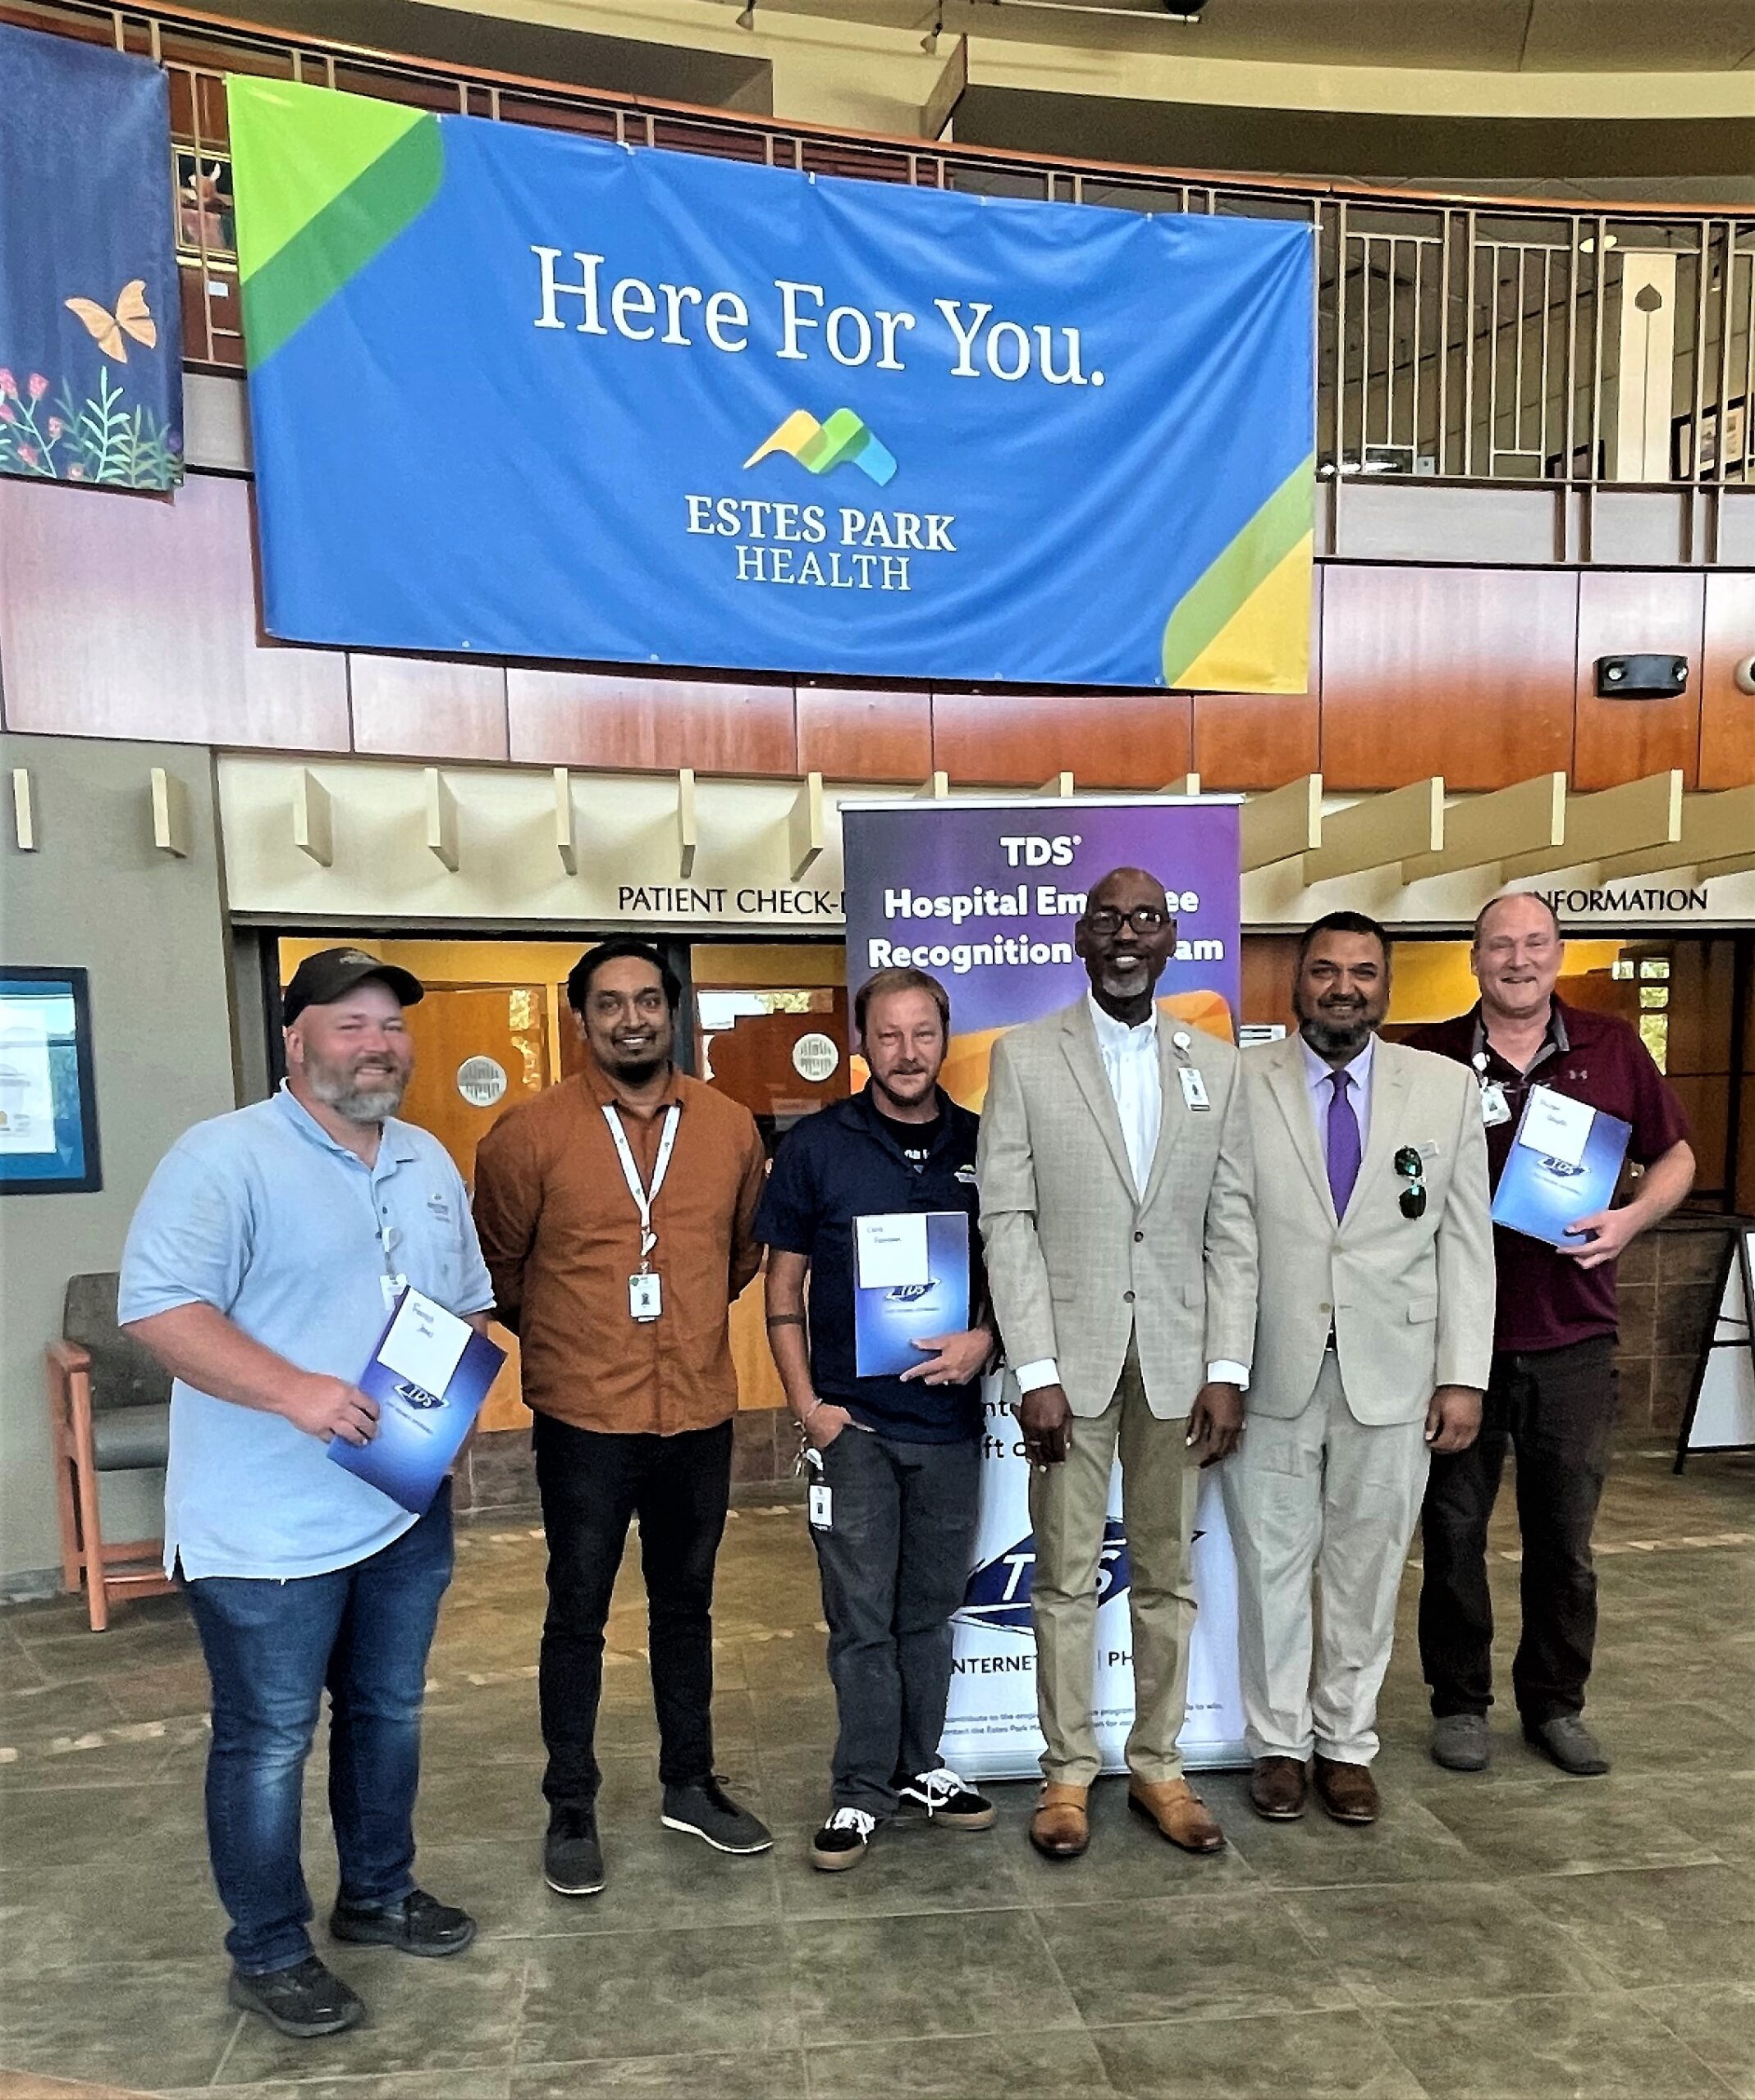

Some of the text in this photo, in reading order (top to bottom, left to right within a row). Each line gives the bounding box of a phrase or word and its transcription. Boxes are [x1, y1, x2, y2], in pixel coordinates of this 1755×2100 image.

[531, 245, 1106, 387] Here For You.
[685, 495, 957, 553] ESTES PARK
[735, 546, 912, 591] HEALTH
[619, 886, 845, 915] PATIENT CHECK-I
[884, 884, 1028, 924] Hospital
[1535, 888, 1708, 912] NFORMATION
[868, 934, 1072, 974] Recognition
[1003, 1547, 1122, 1600] TS
[952, 1655, 1038, 1674] NTERNE
